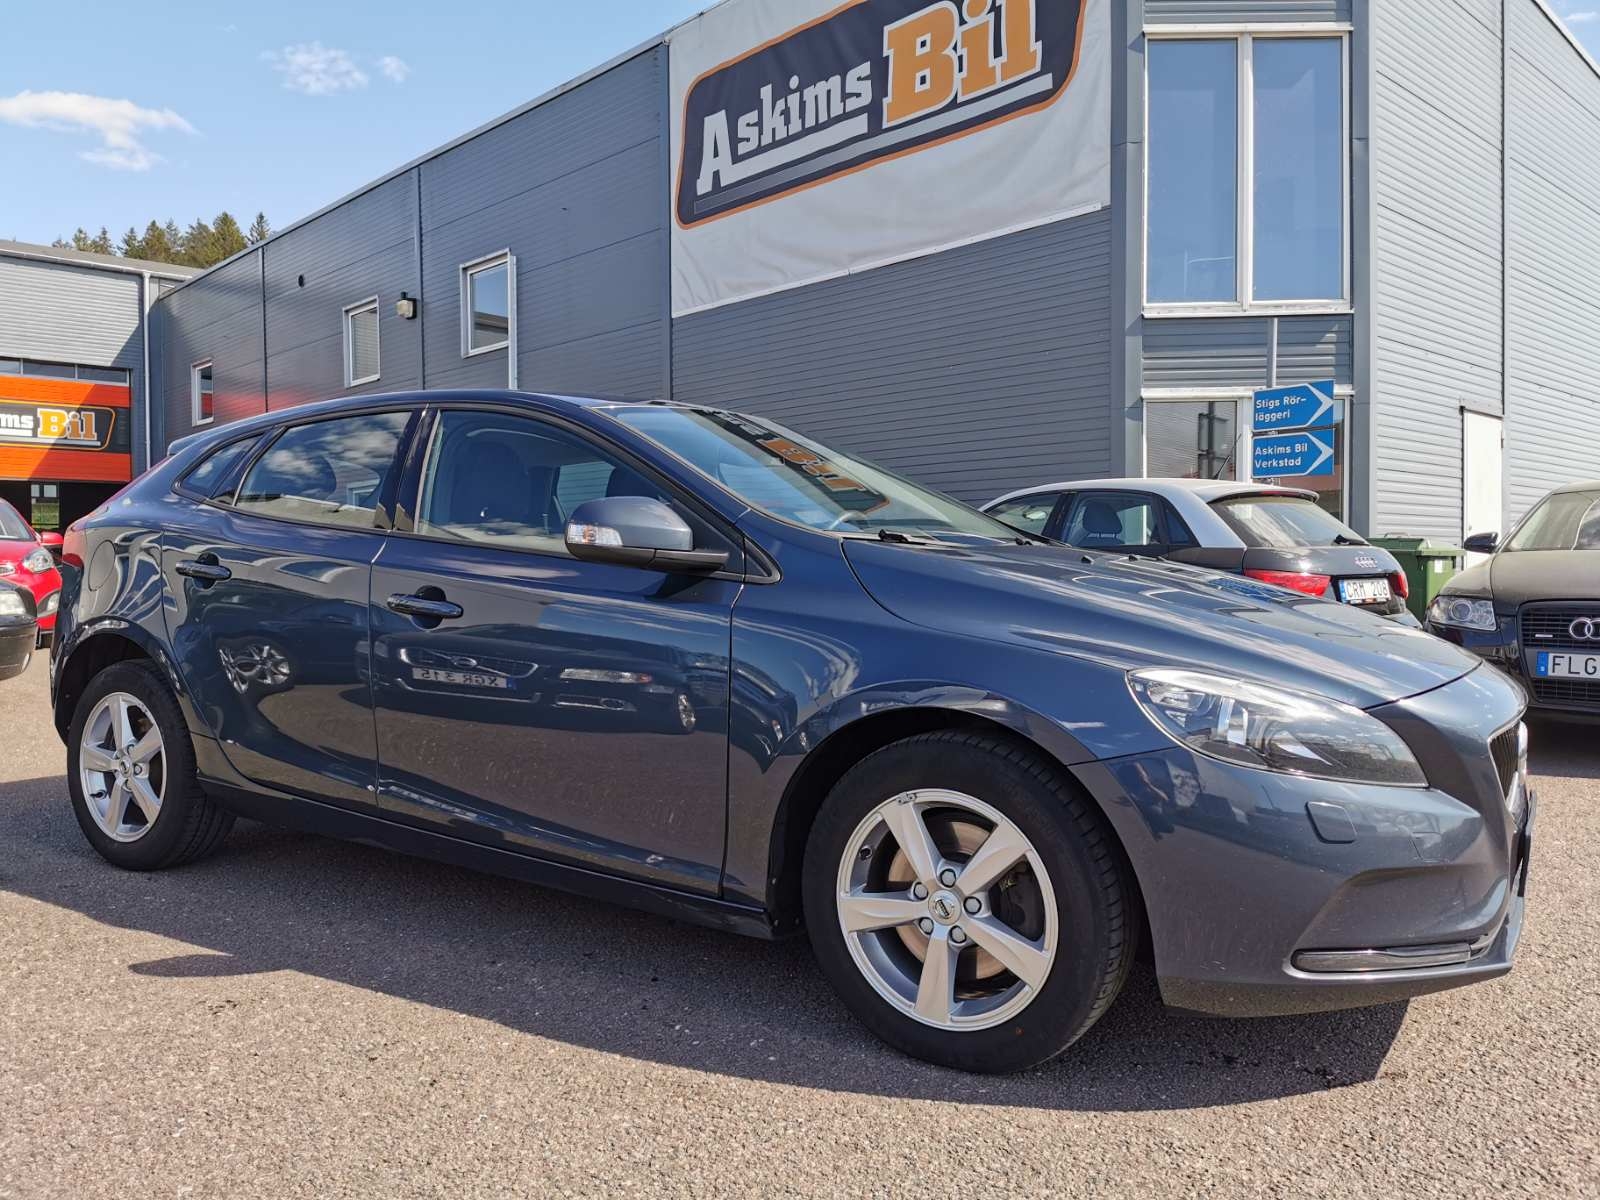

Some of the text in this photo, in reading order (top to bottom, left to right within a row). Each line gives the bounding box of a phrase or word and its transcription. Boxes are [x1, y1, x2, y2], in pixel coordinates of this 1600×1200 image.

[697, 0, 1042, 195] Askims Bil
[1256, 396, 1307, 409] Stigs Rör-
[1255, 409, 1290, 423] läggeri
[37, 408, 98, 441] Bil
[1255, 442, 1308, 455] Askims Bil
[1255, 457, 1302, 469] Verkstad
[1346, 581, 1365, 599] CRM
[1552, 655, 1597, 675] FLG
